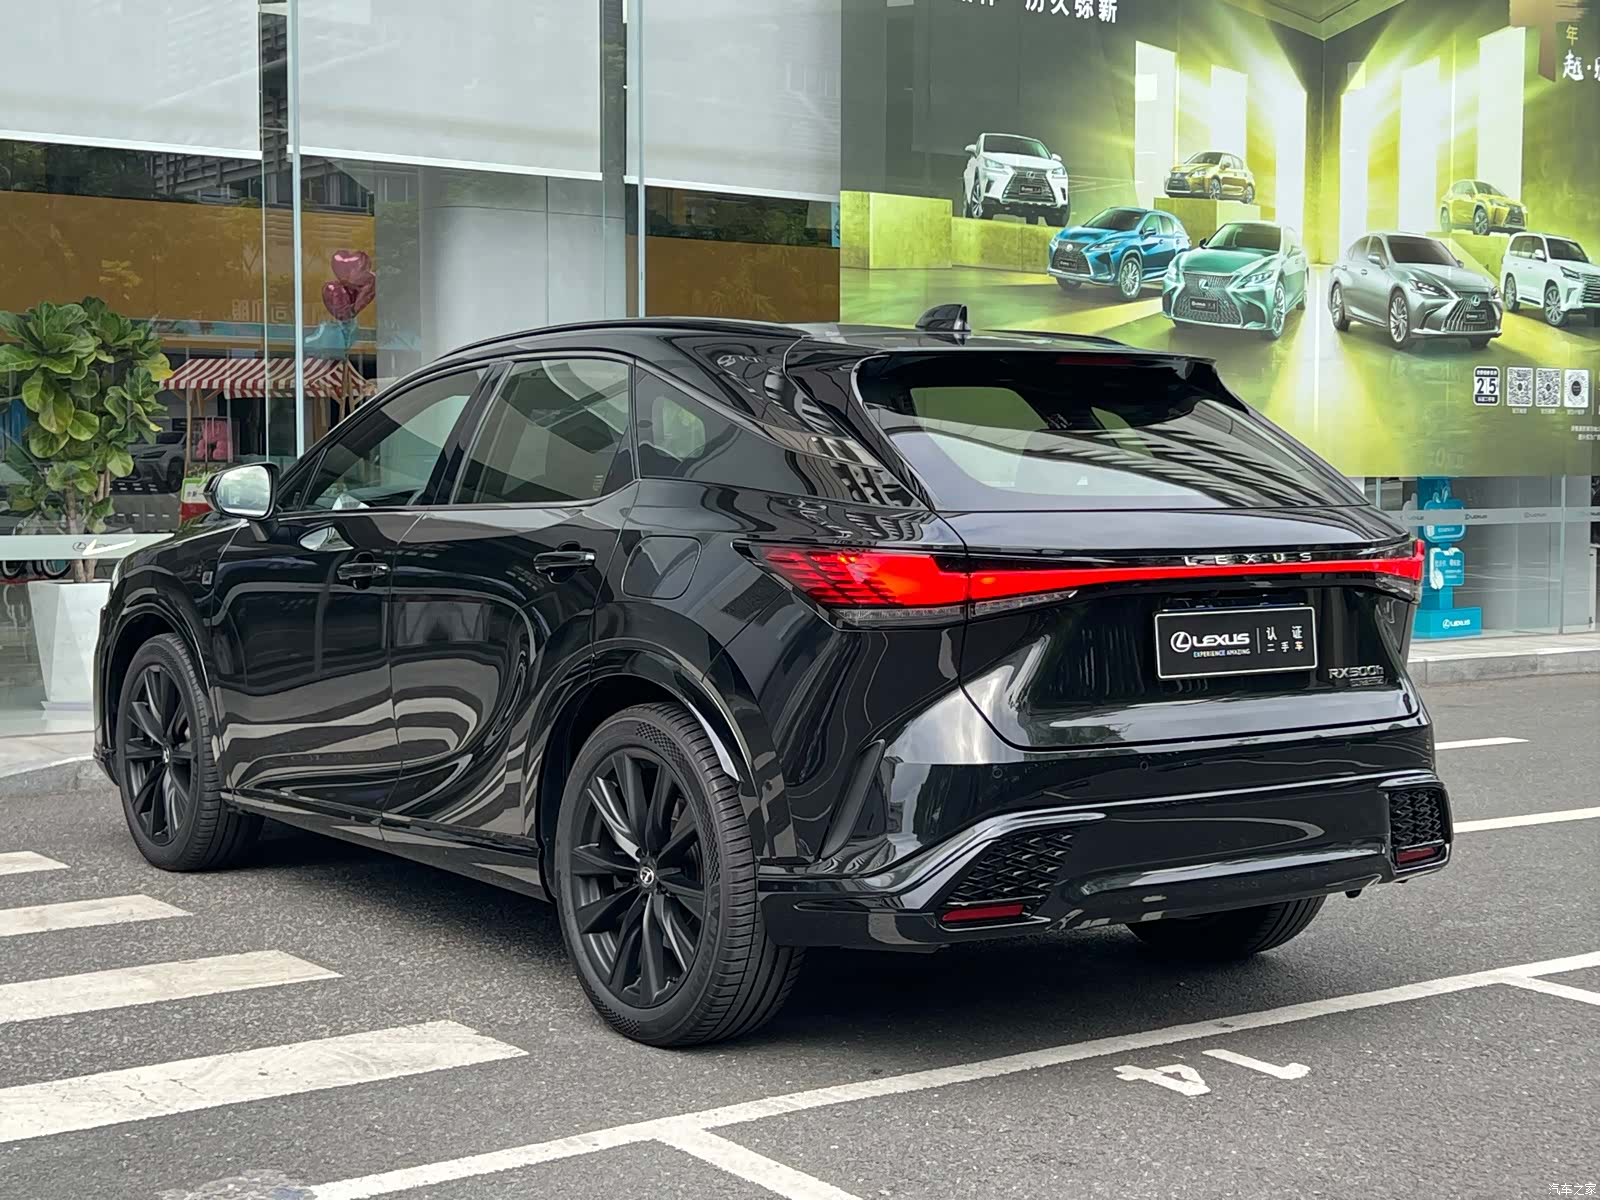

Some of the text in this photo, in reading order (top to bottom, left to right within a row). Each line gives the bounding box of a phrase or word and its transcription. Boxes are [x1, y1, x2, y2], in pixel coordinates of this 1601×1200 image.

[1566, 24, 1579, 46] 年
[1563, 49, 1600, 81] 越·
[1184, 552, 1312, 566] LEXUS
[1192, 633, 1250, 647] LEXUS
[1266, 625, 1303, 641] 认证
[1267, 641, 1304, 653] 二手车
